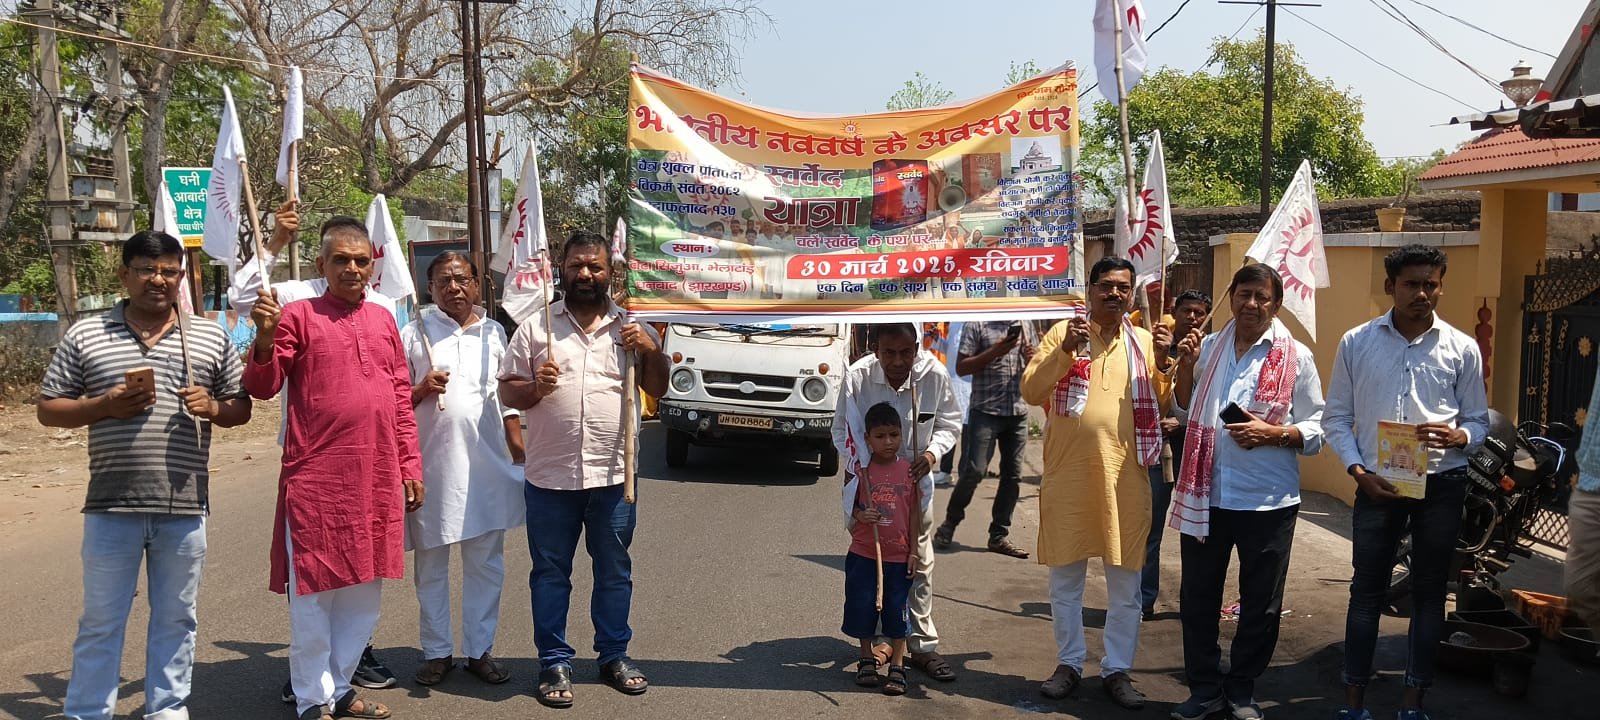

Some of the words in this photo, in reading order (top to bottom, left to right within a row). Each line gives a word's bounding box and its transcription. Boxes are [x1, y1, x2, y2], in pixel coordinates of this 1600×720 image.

[635, 105, 760, 149] भरतीय
[766, 131, 866, 156] नववर्ष
[872, 130, 907, 156] के
[916, 108, 1021, 149] अवसर
[1027, 105, 1072, 132] पर
[661, 161, 695, 175] शुक्ल
[763, 163, 844, 188] स्वर्वेद
[178, 171, 200, 186] घनी
[638, 179, 673, 194] विक्रम
[677, 181, 706, 195] संवत
[183, 205, 202, 219] क्षेत्र
[646, 201, 708, 216] दाफलाब्द
[712, 205, 736, 216] १३७
[763, 196, 861, 228] यात्रा
[672, 243, 705, 253] स्थान
[822, 235, 859, 249] स्वर्वेद
[867, 234, 882, 247] के
[885, 235, 909, 246] पथ
[800, 260, 832, 277] 30
[839, 255, 889, 276] मार्च
[896, 256, 962, 276] 2025,
[970, 250, 1056, 273] रविवार
[817, 283, 837, 293] एक
[840, 281, 864, 293] दिन
[879, 283, 898, 292] एक
[902, 282, 927, 293] साथ
[942, 282, 962, 292] एक
[966, 281, 998, 292] समय
[1005, 278, 1038, 291] स्वर्वेद
